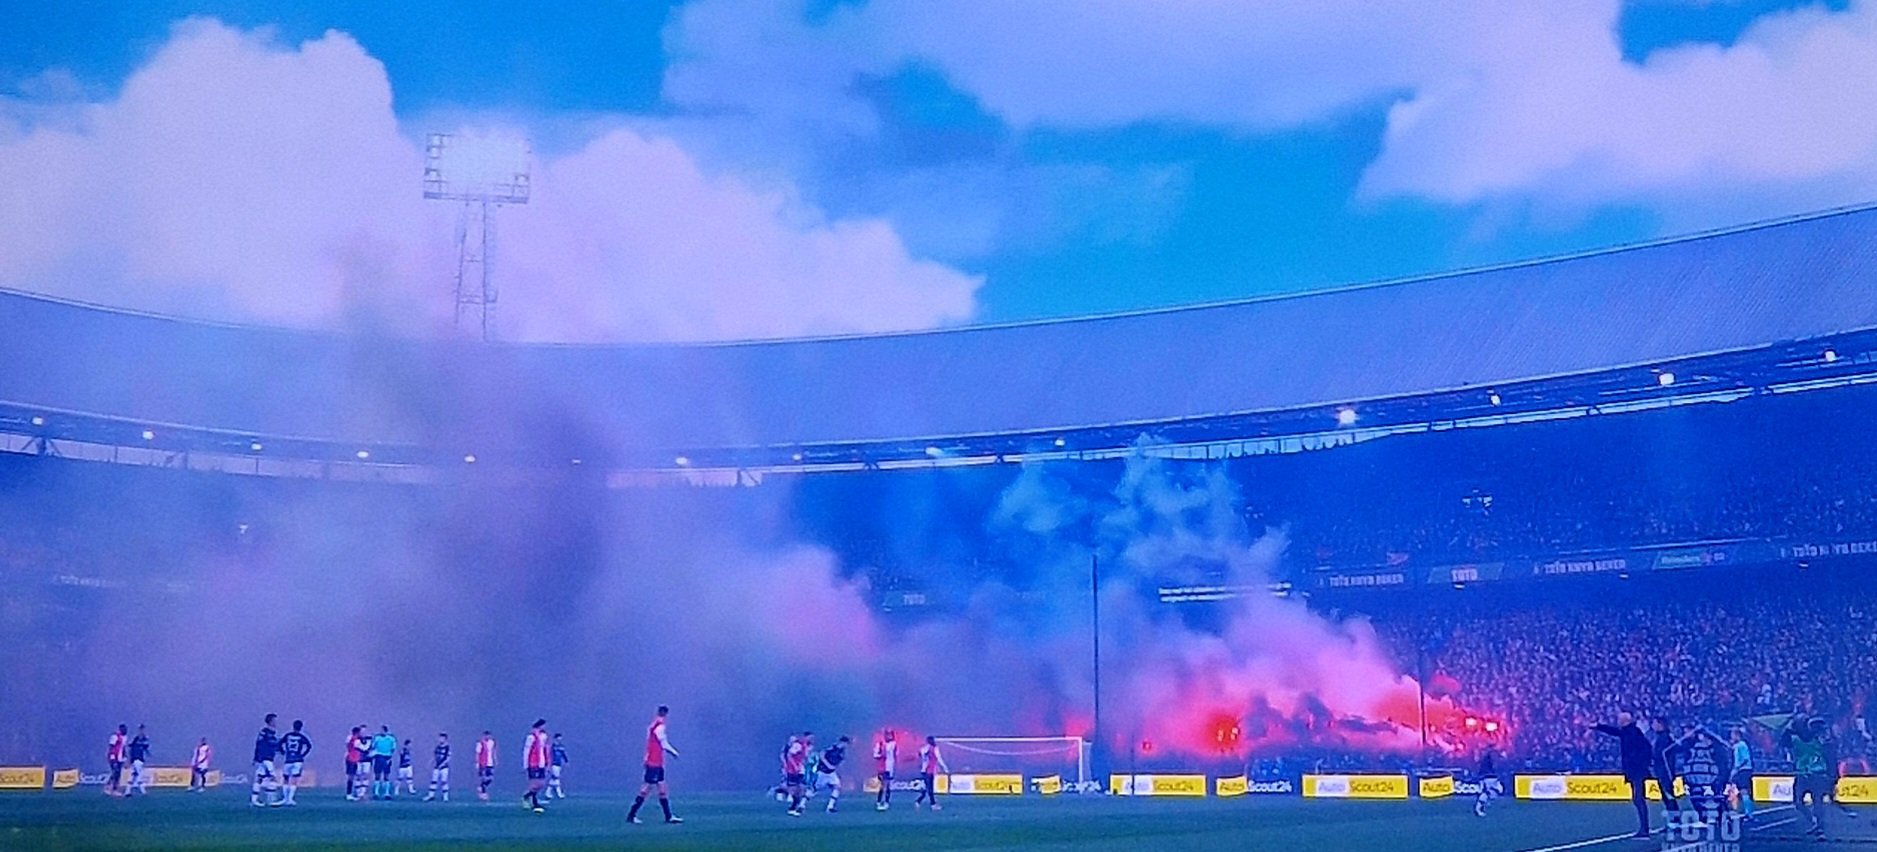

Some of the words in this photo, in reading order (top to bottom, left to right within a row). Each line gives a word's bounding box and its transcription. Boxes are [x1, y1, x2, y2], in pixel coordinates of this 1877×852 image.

[1451, 568, 1478, 582] TOTO
[1154, 779, 1194, 792] Scout24
[1219, 780, 1245, 792] Auto
[1248, 780, 1292, 792] Scout24
[1318, 780, 1346, 792] Auto
[1350, 779, 1394, 792] Scout24
[1422, 781, 1450, 793] Auto
[1532, 780, 1562, 793] Auto
[1566, 781, 1617, 794] Scout24
